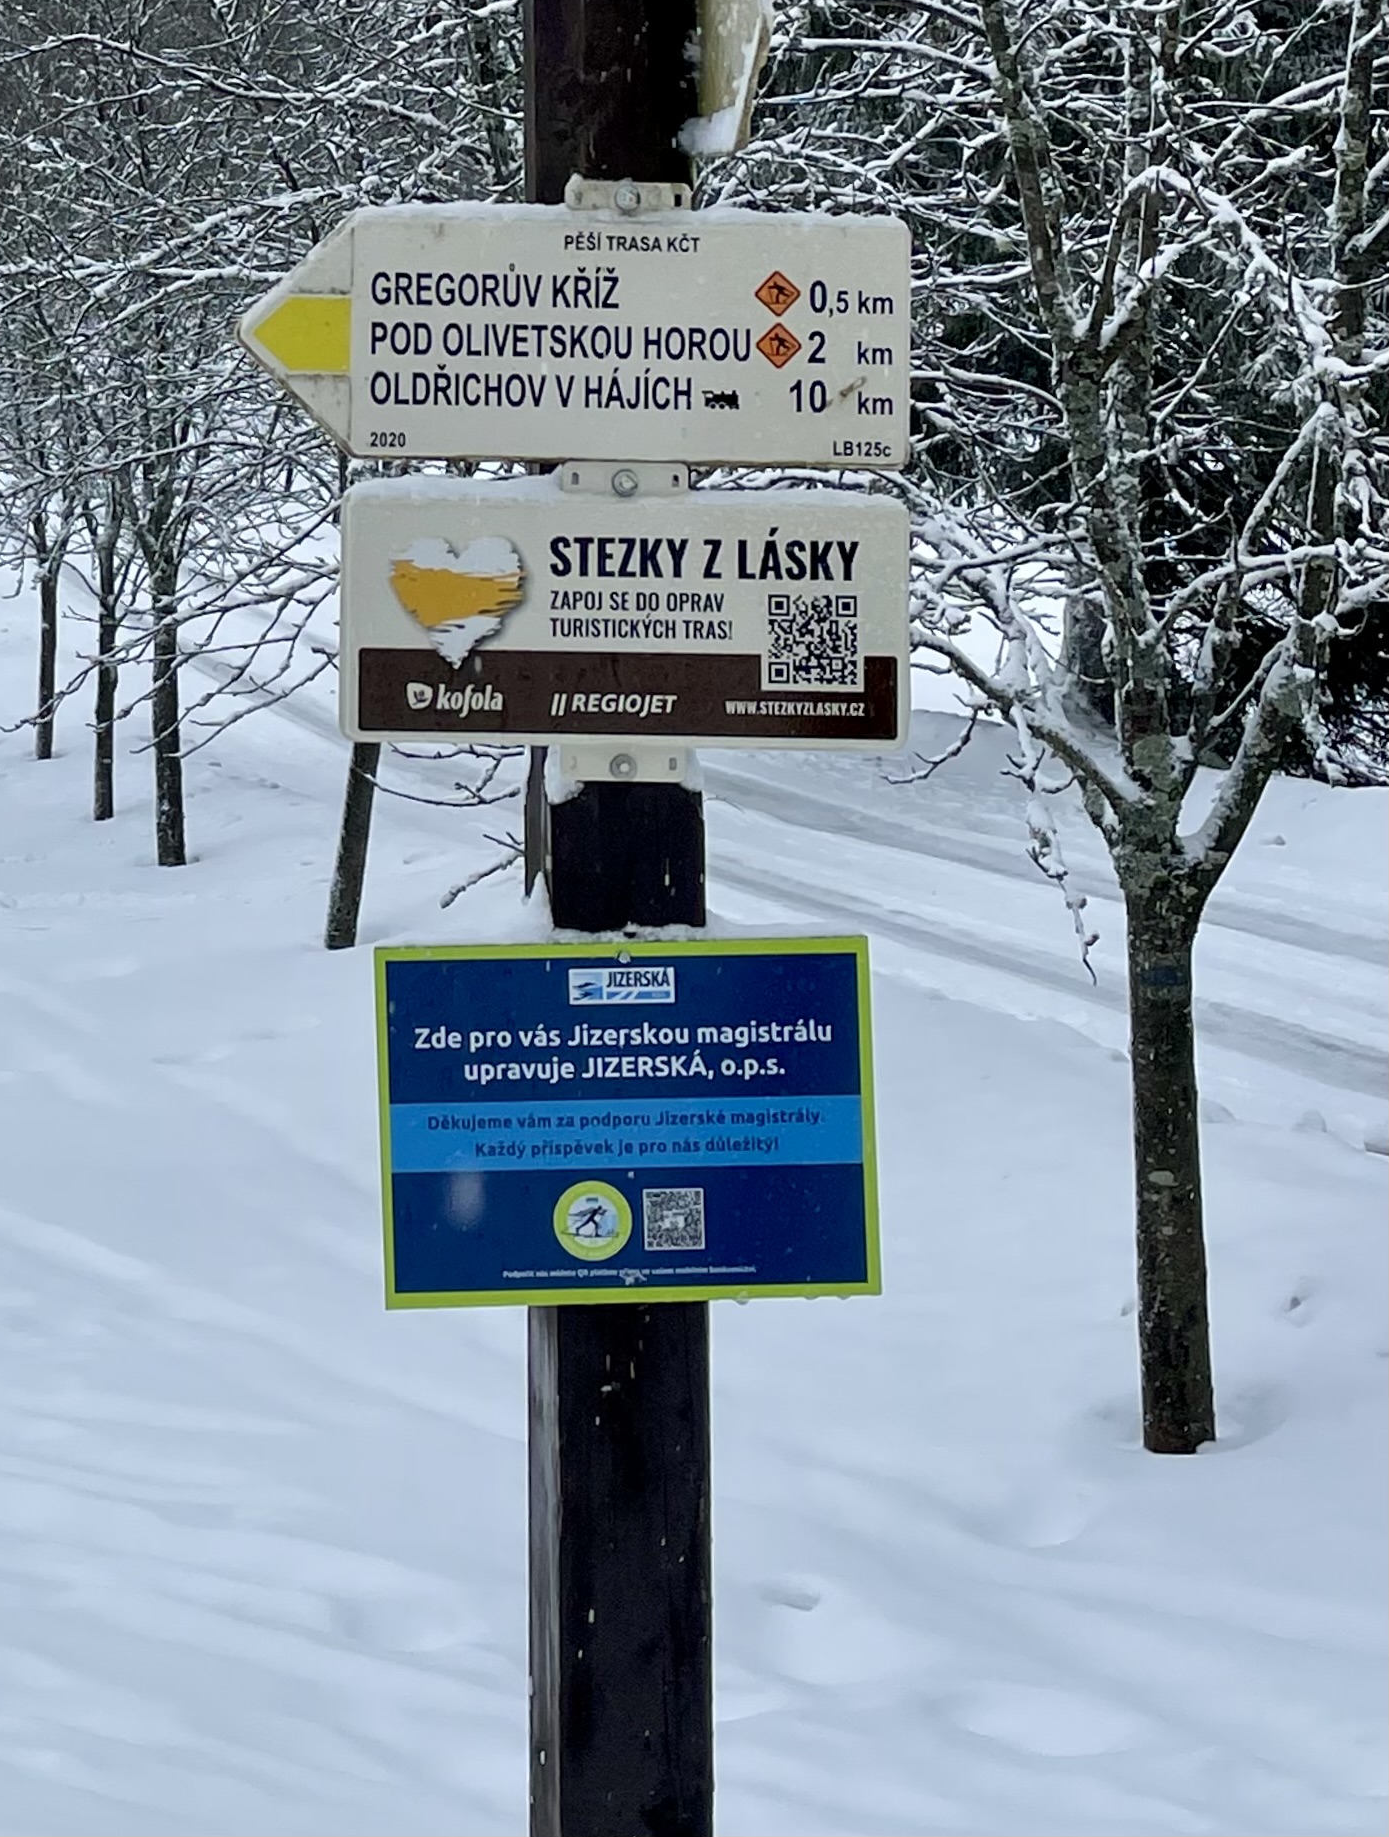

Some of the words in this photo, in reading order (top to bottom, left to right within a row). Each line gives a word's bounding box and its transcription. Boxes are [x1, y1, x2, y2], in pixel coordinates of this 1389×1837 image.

[564, 232, 601, 251] PĚŠÍ
[606, 235, 662, 252] TRASA
[667, 233, 700, 253] KČT
[370, 263, 542, 308] GREGORŮV
[551, 267, 620, 310] KŘÍŽ
[809, 280, 849, 318] 0,5
[858, 290, 894, 315] km
[370, 321, 432, 356] POD
[442, 323, 633, 360] OLIVETSKOU
[643, 326, 752, 362] HOROU
[807, 330, 826, 364] 2
[857, 341, 893, 365] km
[369, 364, 547, 408] OLDŘICHOV
[555, 374, 576, 408] V
[584, 367, 693, 411] HÁJÍCH
[789, 379, 827, 413] 10
[857, 391, 894, 415] km
[370, 431, 406, 448] 2020
[833, 441, 892, 457] LB125c
[549, 535, 689, 579] STEZKY
[702, 539, 723, 579] Z
[737, 526, 860, 581] LÁSKY
[550, 590, 603, 611] ZAPOJ
[609, 591, 630, 611] SE
[635, 593, 660, 611] DO
[666, 593, 725, 613] OPRAV
[550, 614, 677, 639] TURISTICKÝCH
[682, 620, 733, 640] TRAS!
[436, 683, 504, 718] kofola
[571, 693, 677, 718] REGIOJET
[725, 700, 866, 717] WWW.STEZKYZLASKY.CZ
[606, 966, 671, 988] JIZERSKÁ
[414, 1025, 462, 1049] Zde
[469, 1031, 512, 1053] pro
[518, 1023, 561, 1047] vás
[567, 1021, 689, 1047] Jizerskou
[697, 1018, 832, 1048] magistrálu
[464, 1056, 575, 1085] upravuje
[581, 1049, 714, 1080] JIZERSKÁ,
[721, 1057, 786, 1080] o.p.s.
[427, 1114, 512, 1132] Děkujeme
[516, 1112, 551, 1129] vám
[555, 1116, 575, 1128] za
[579, 1111, 651, 1131] podporu
[655, 1109, 726, 1127] Jizerské
[475, 1140, 526, 1159] Každý
[617, 1138, 634, 1157] je
[638, 1141, 667, 1157] pro
[672, 1136, 702, 1153] nás
